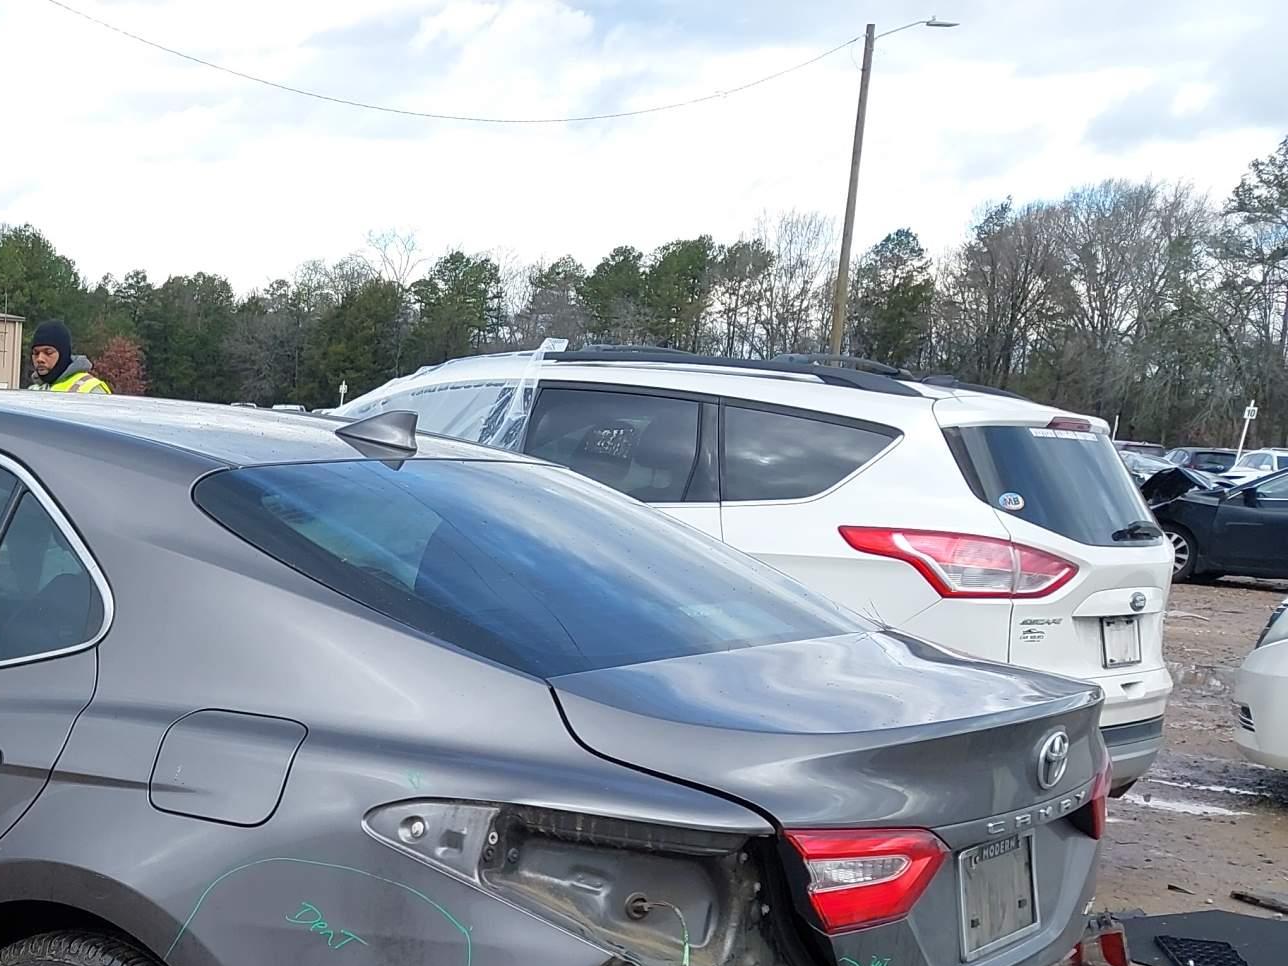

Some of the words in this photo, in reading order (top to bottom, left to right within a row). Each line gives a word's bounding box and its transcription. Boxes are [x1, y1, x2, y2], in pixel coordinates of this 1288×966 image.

[1247, 409, 1256, 417] 10
[987, 790, 1086, 834] CAMRY
[982, 838, 1016, 860] MODERN
